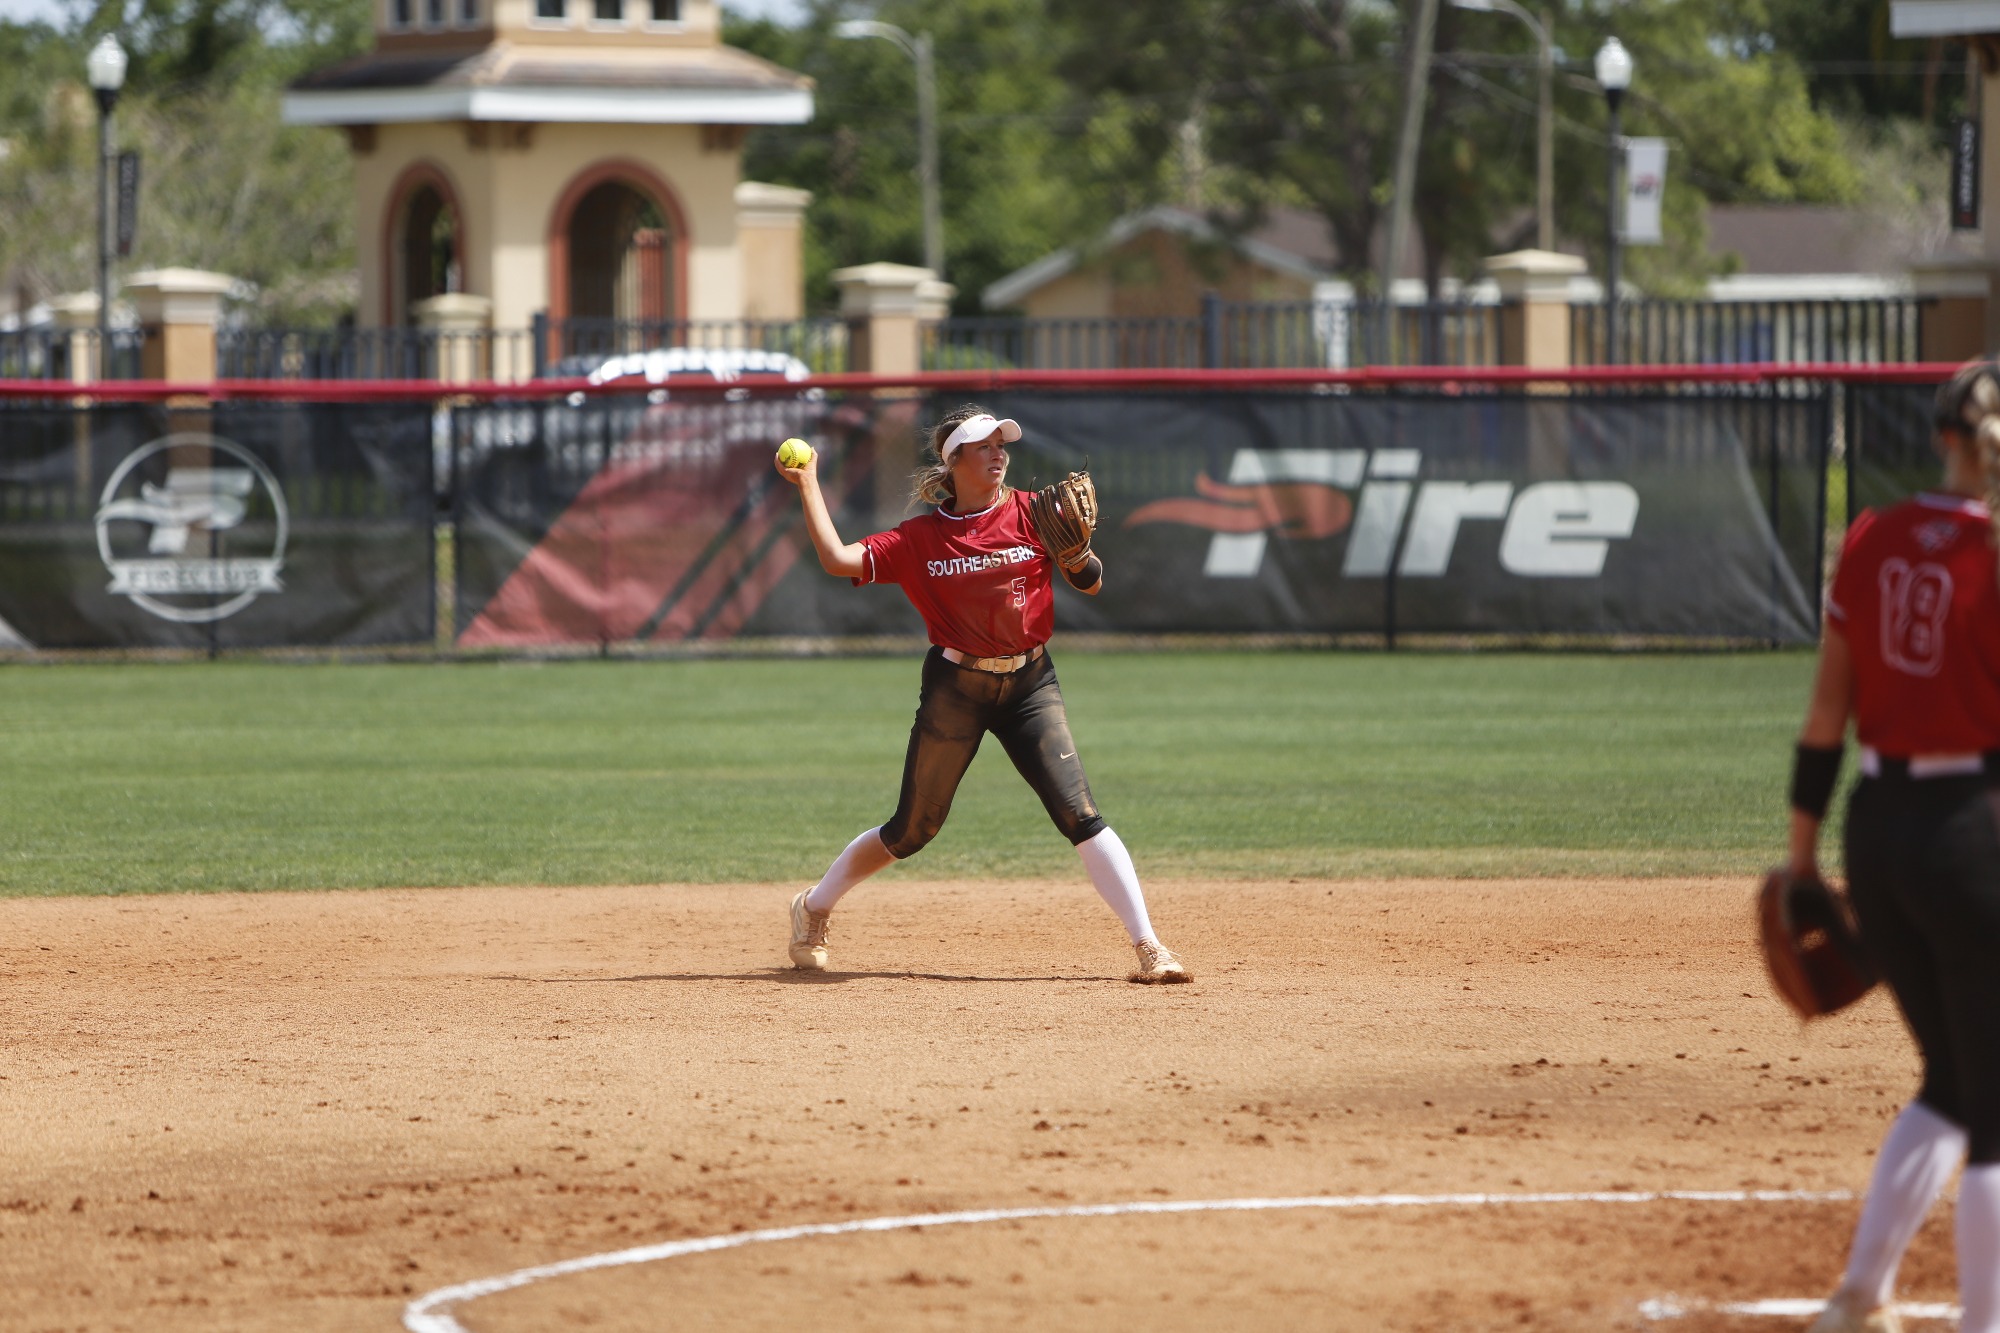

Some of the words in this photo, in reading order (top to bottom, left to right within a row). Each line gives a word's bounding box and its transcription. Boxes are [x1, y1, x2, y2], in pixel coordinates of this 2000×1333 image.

[1203, 448, 1640, 577] Fire
[926, 545, 1035, 577] SOUTHEASTERN
[1011, 576, 1027, 607] 5
[1878, 555, 1954, 678] 18
